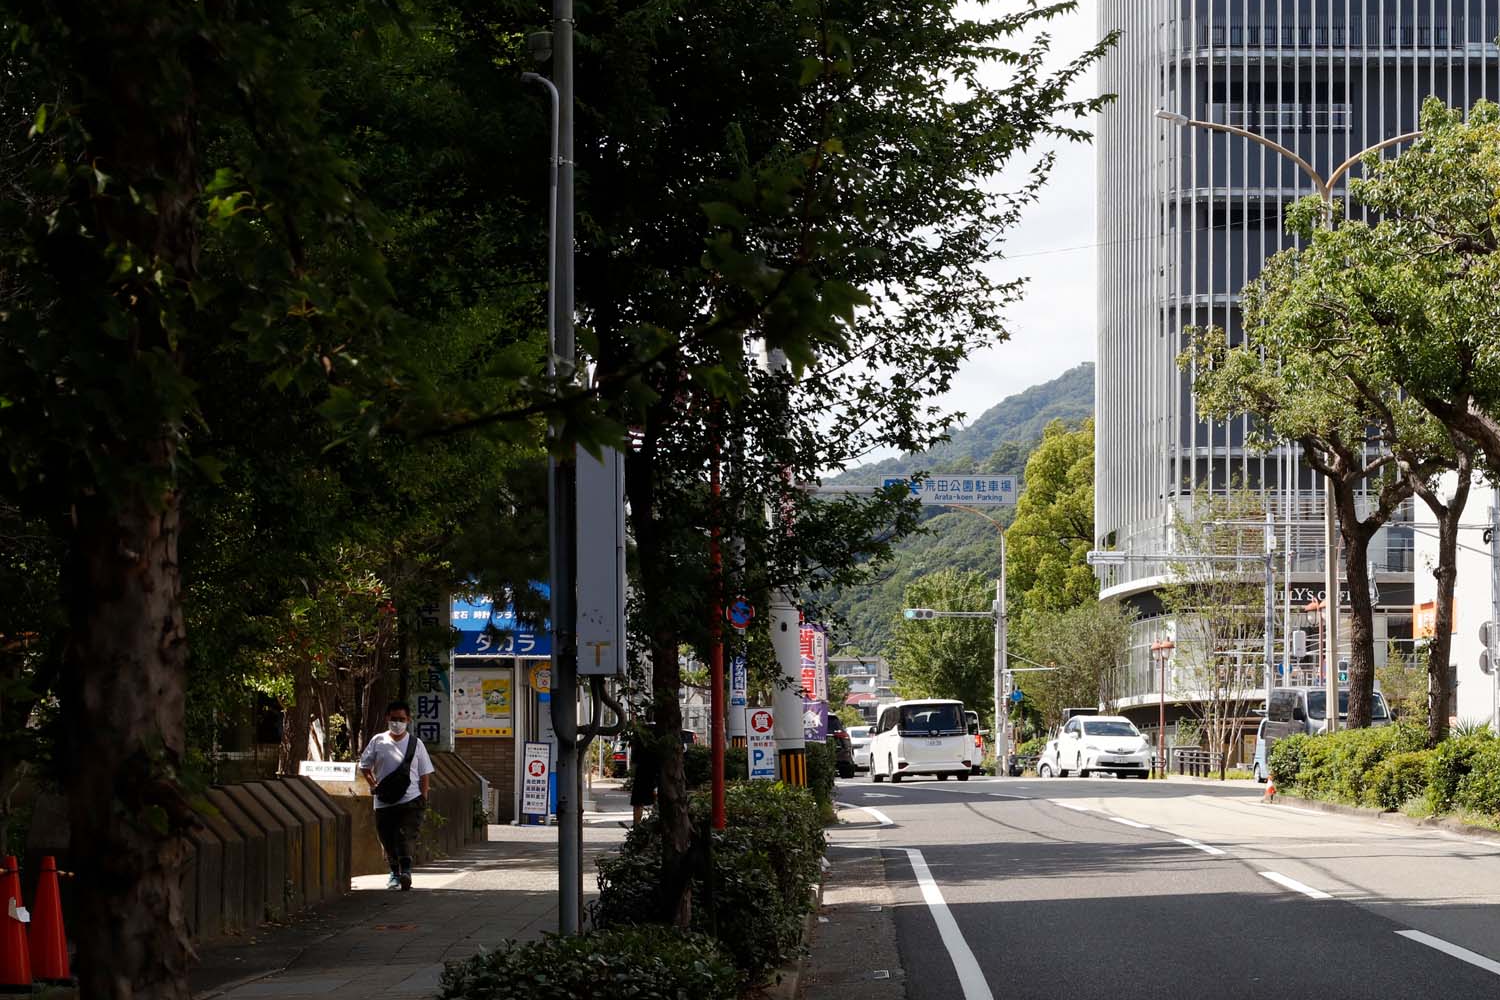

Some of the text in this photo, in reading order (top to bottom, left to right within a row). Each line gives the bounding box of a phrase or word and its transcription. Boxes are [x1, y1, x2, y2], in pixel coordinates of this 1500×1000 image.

[924, 479, 1012, 492] 荒田公園駐車場
[934, 493, 1003, 502] Arata-koen Parking
[476, 633, 536, 652] タカラ
[753, 750, 765, 766] P
